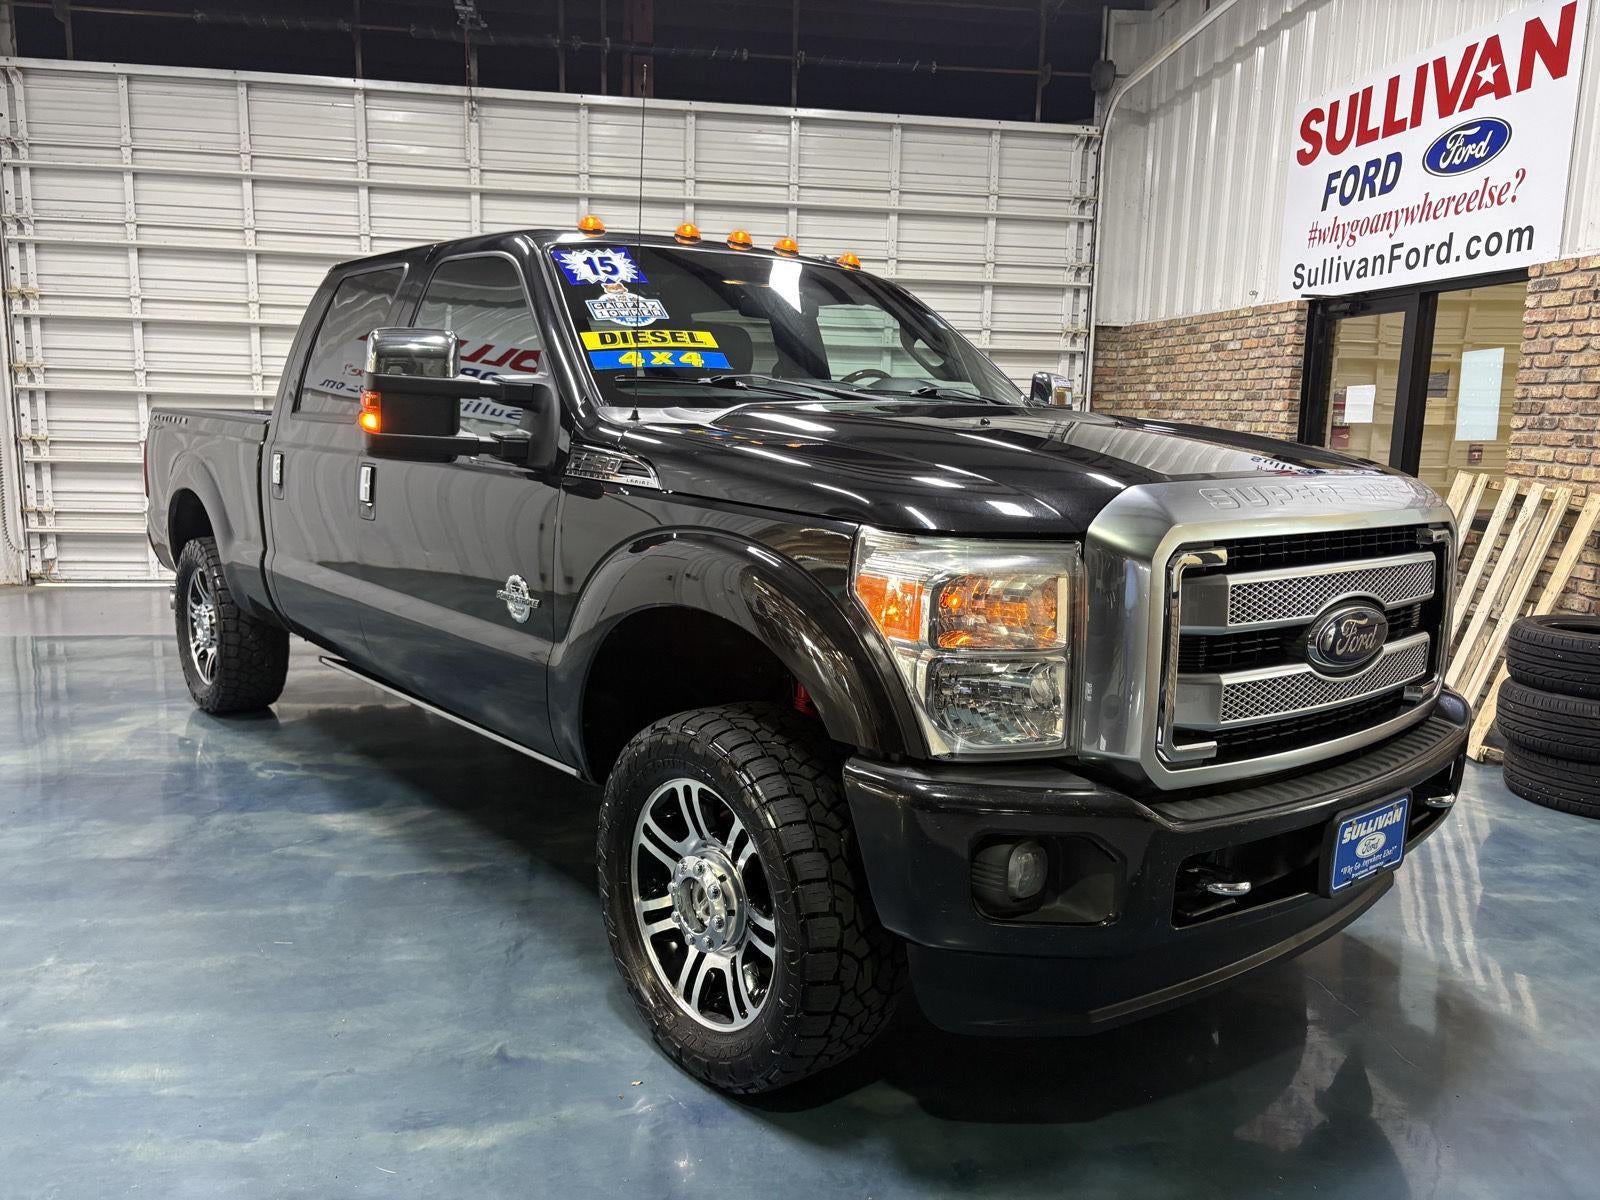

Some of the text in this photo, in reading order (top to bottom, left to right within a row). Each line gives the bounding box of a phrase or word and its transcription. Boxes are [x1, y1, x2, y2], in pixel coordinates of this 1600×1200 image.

[1296, 1, 1577, 166] SULLIVAN
[1321, 151, 1403, 212] FORD
[1308, 168, 1526, 250] #whygoanywhereelse?
[583, 256, 616, 276] 15
[1292, 224, 1534, 290] SullivanFord.com
[599, 331, 704, 345] DIESEL
[1335, 617, 1379, 657] Ford
[1341, 806, 1404, 845] SULLIVAN
